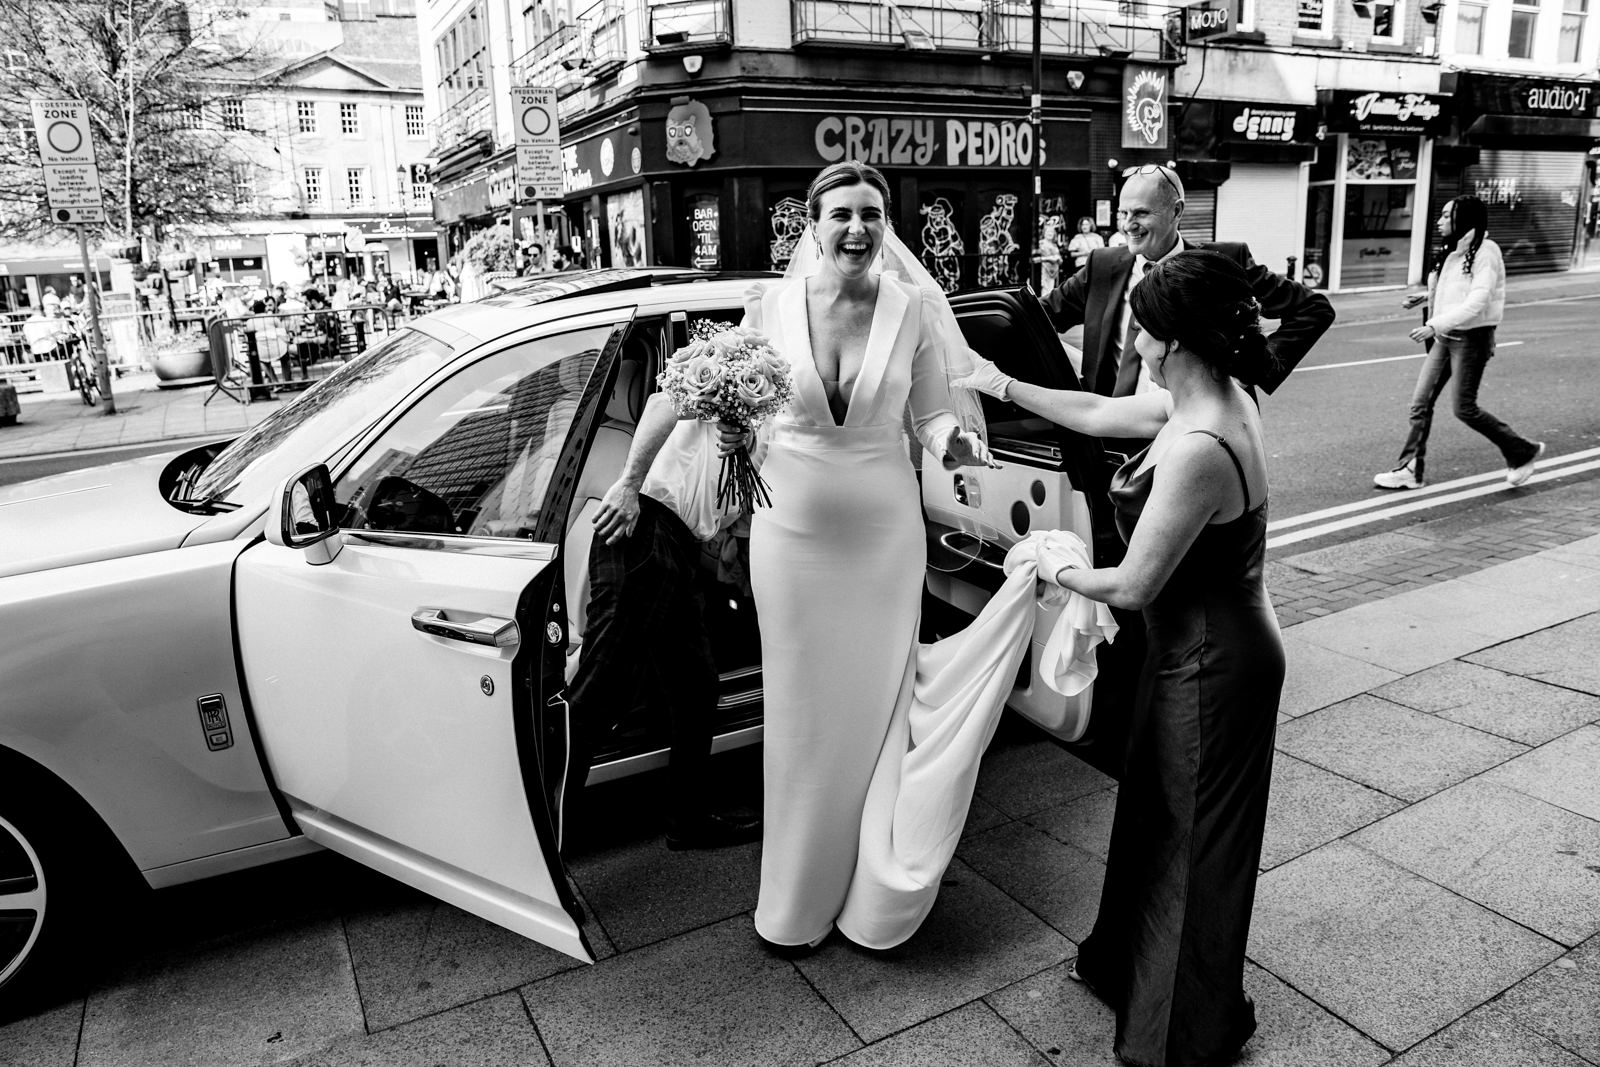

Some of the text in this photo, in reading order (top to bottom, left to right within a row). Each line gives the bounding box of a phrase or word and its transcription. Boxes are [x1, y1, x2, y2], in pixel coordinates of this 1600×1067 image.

[1191, 8, 1228, 30] MOJO
[521, 96, 548, 104] ZONE
[44, 110, 78, 118] ZONE
[1233, 107, 1295, 141] denny
[815, 116, 939, 166] CRAZY
[694, 208, 713, 219] BAR
[692, 219, 717, 231] OPEN
[694, 244, 717, 256] 4AM
